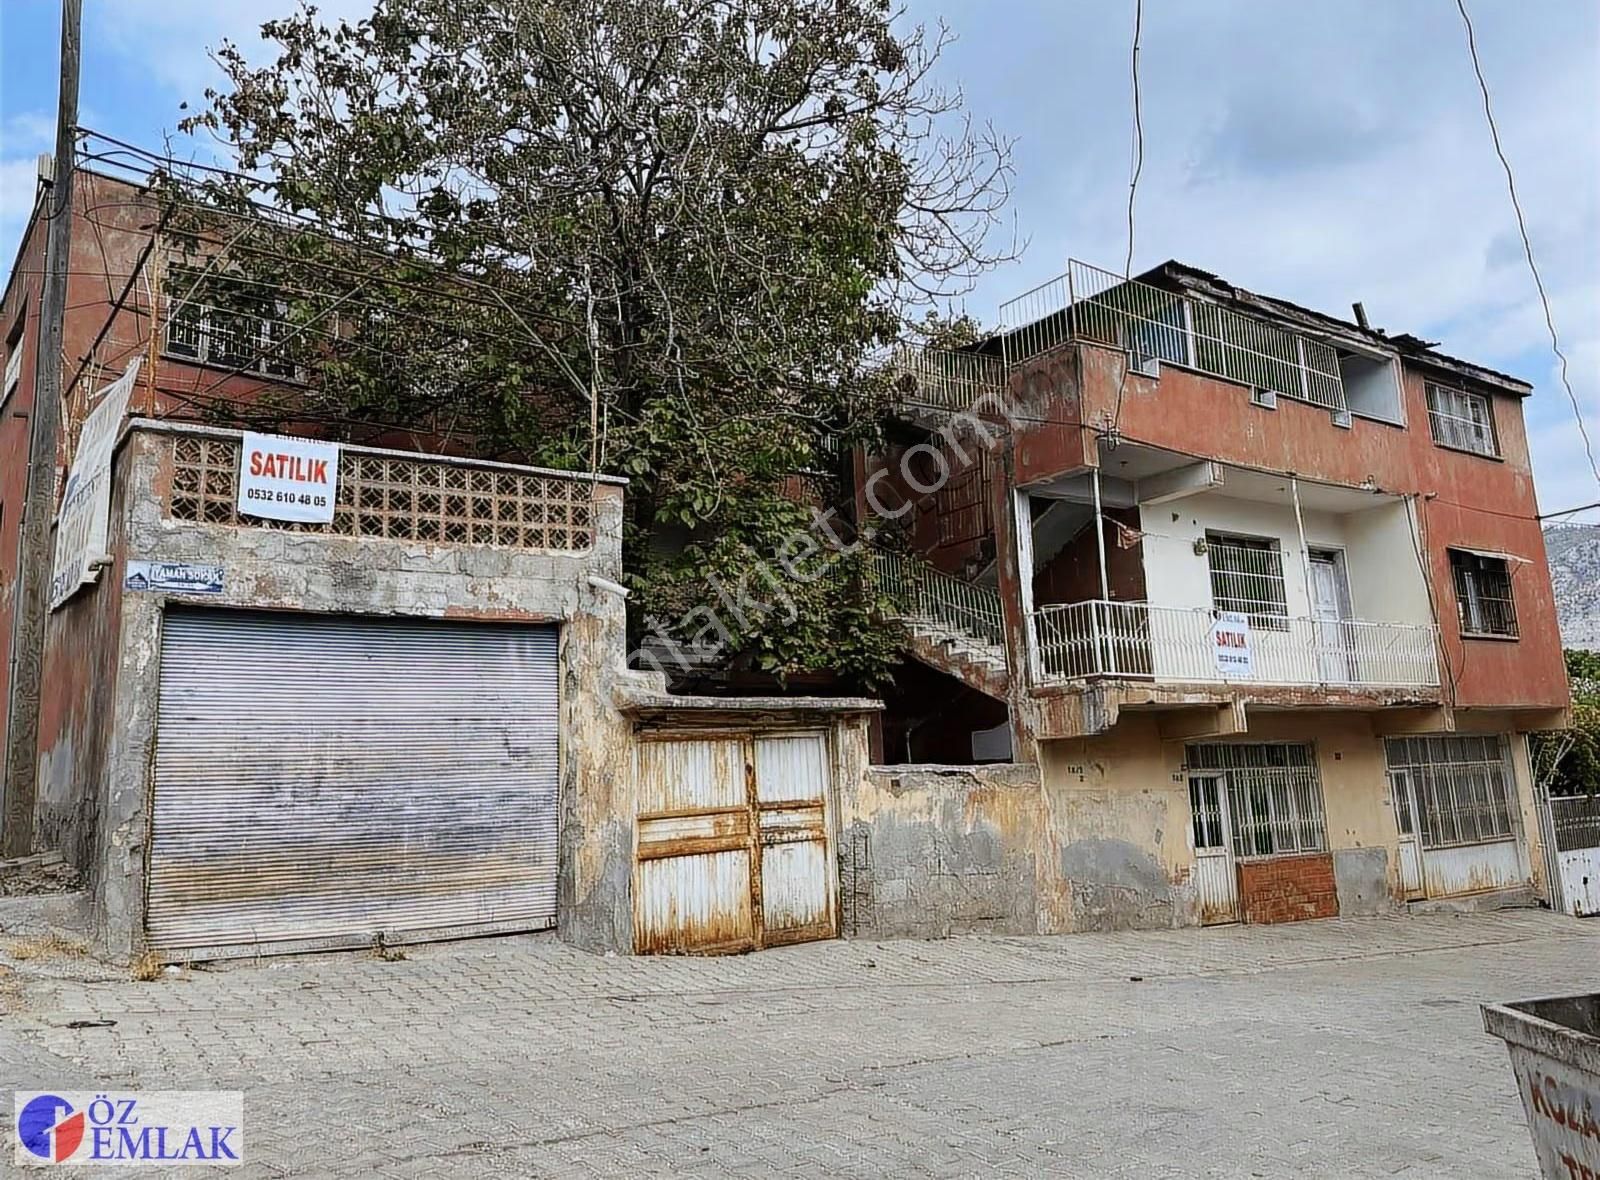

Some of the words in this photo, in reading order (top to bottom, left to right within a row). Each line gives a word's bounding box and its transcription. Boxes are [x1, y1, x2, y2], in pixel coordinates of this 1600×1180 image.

[250, 450, 328, 484] SATILIK
[247, 488, 274, 502] 0532
[276, 491, 296, 504] 610
[298, 494, 311, 506] 48
[313, 496, 327, 508] 05
[1216, 630, 1247, 649] SATILIK
